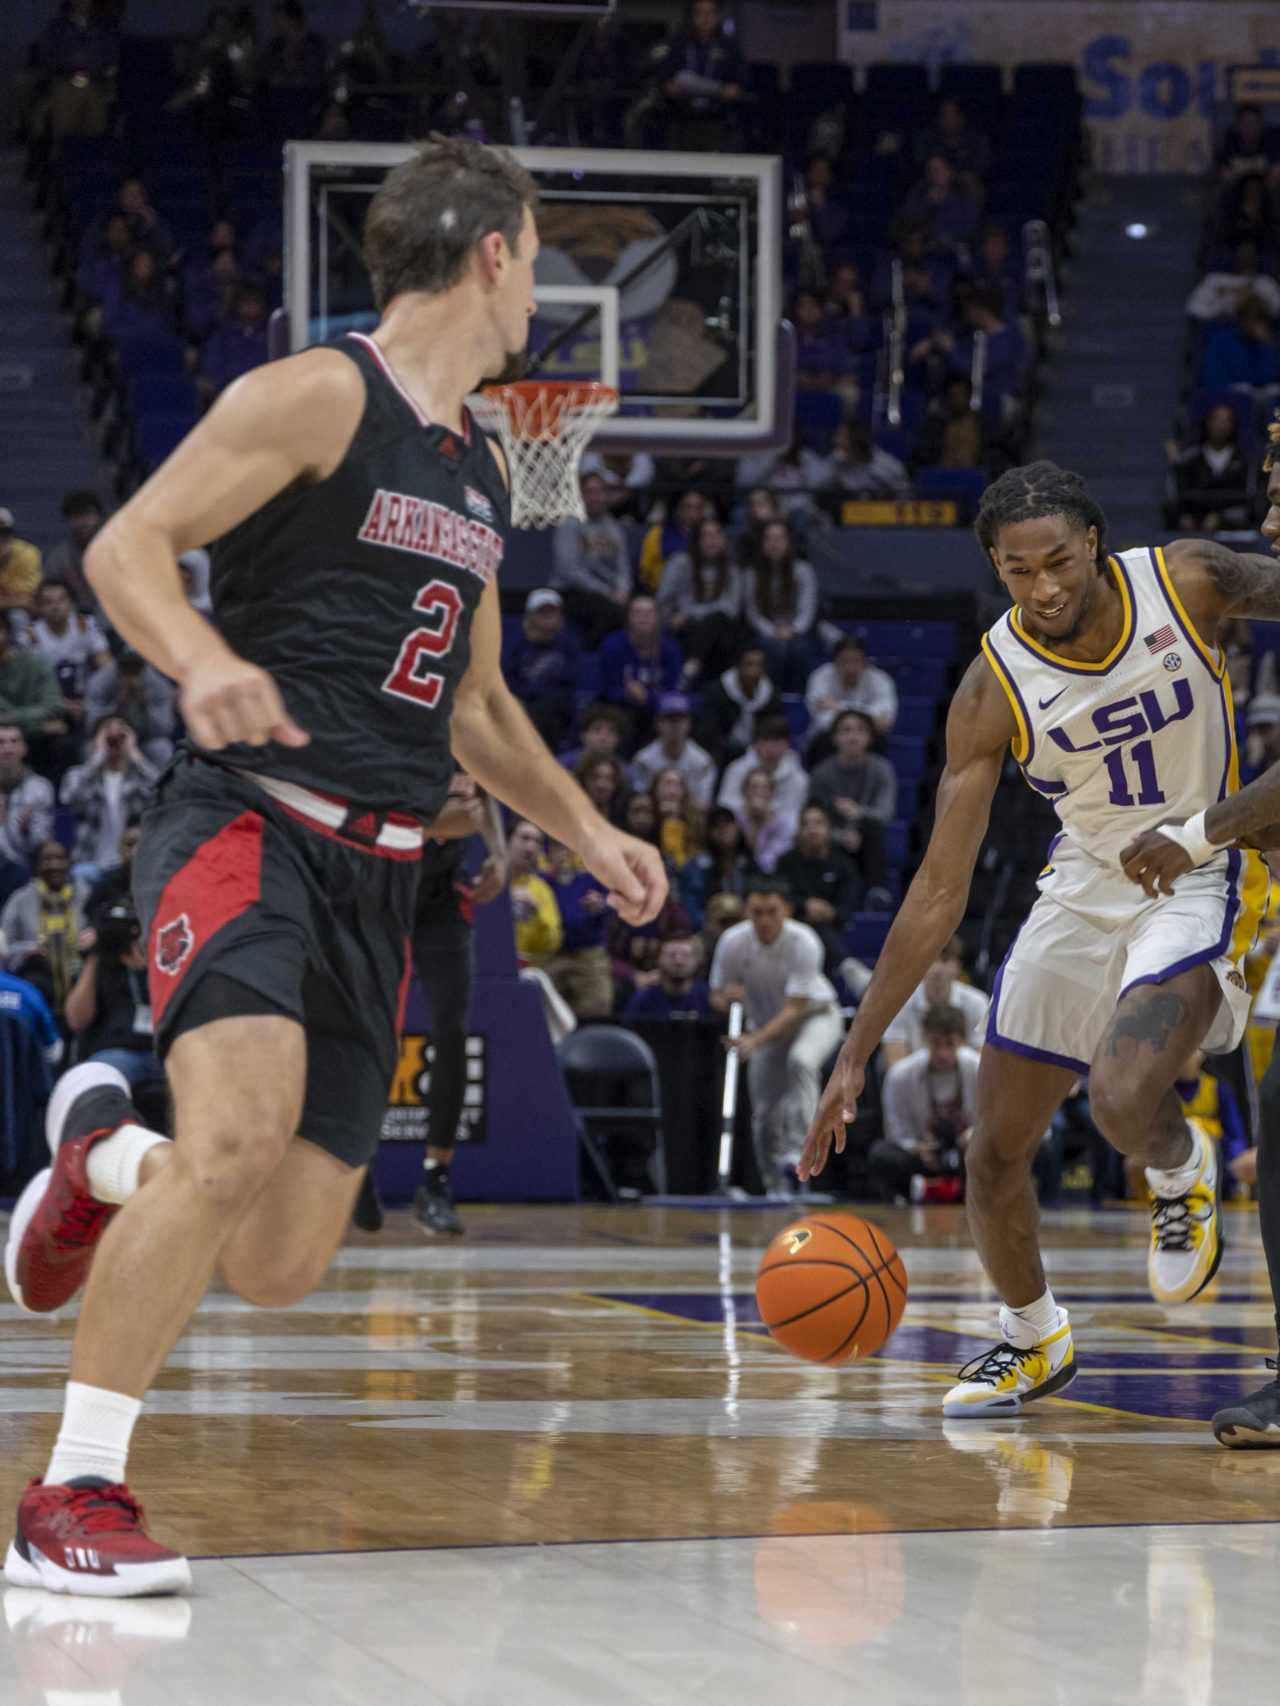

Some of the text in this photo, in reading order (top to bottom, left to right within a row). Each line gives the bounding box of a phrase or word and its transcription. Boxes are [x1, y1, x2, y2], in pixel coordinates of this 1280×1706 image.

[381, 579, 463, 709] 2
[1047, 678, 1194, 752] LSU
[1103, 740, 1165, 806] 11
